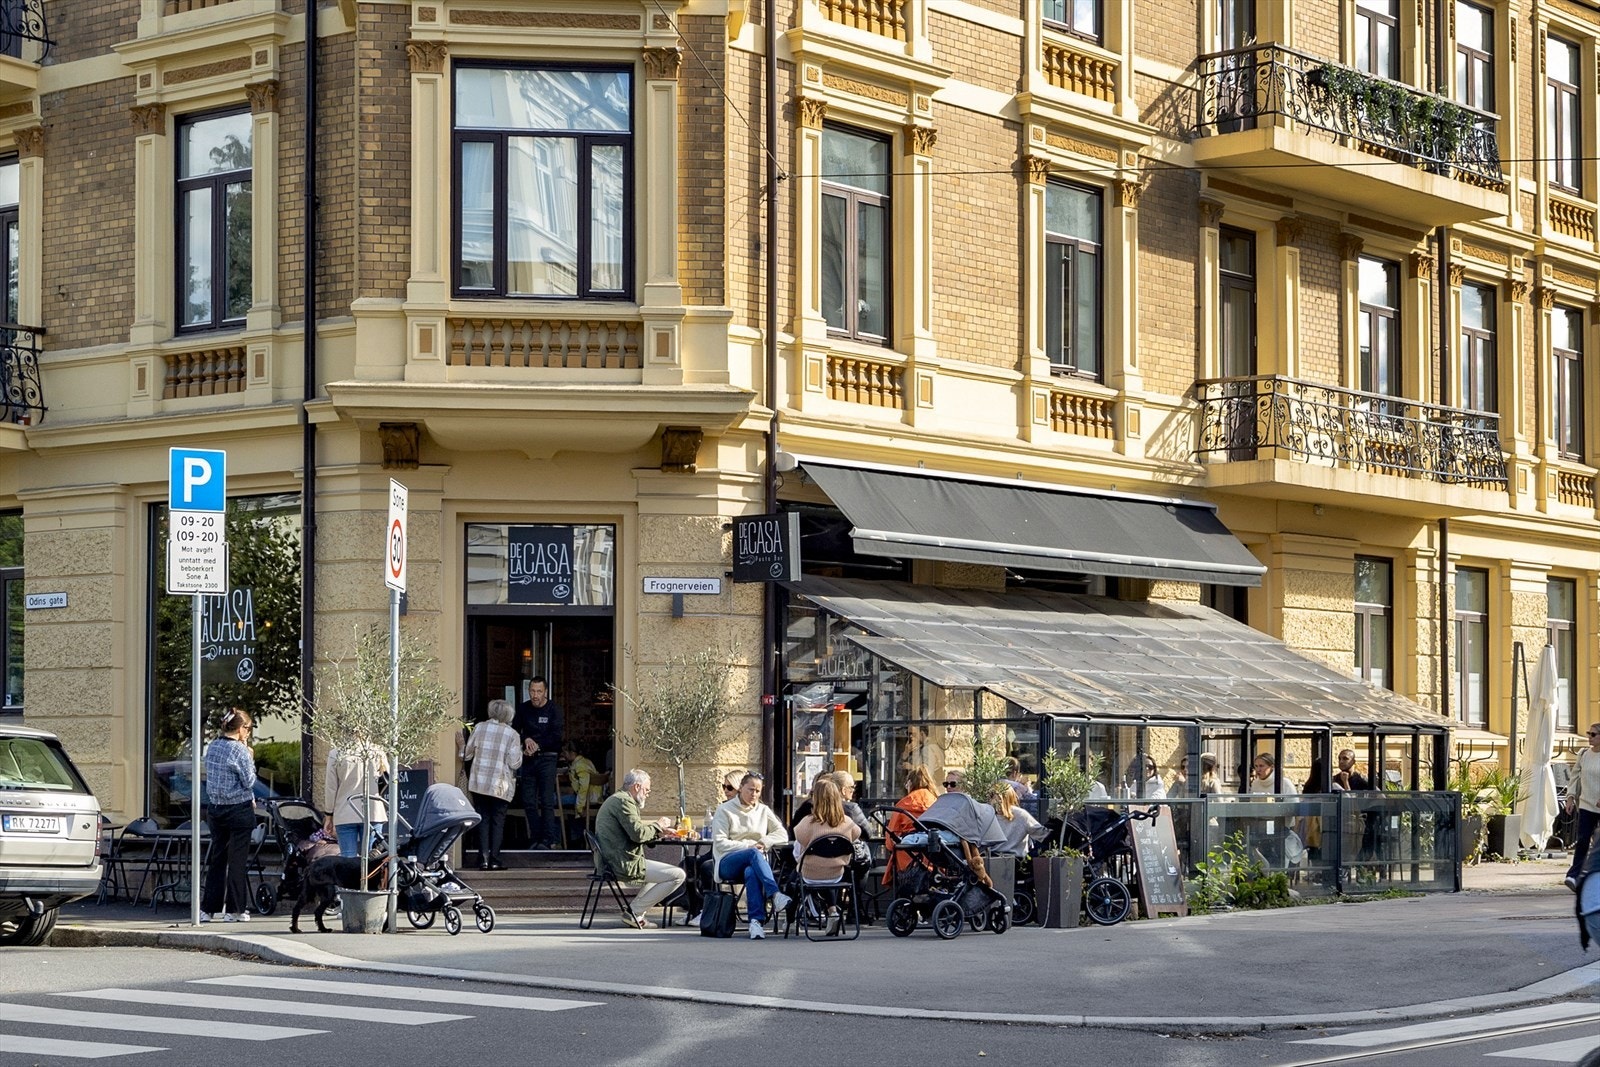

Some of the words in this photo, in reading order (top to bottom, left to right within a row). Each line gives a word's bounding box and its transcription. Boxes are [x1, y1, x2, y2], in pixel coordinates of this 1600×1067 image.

[183, 457, 212, 503] P
[180, 516, 214, 527] 09-20
[176, 530, 219, 543] (09-20)
[739, 522, 748, 539] DE
[748, 520, 783, 554] CASA
[195, 546, 214, 555] avgift
[392, 533, 403, 564] 30
[739, 539, 749, 555] LA
[178, 556, 201, 564] unntatt
[203, 557, 216, 565] med
[510, 542, 522, 558] DE
[523, 542, 572, 575] CASA
[180, 565, 214, 573] beboerkort
[510, 558, 523, 575] LA
[532, 575, 554, 583] Pasta
[558, 575, 571, 583] Bar
[650, 580, 714, 593] Frognerveien
[29, 597, 47, 606] Odins
[48, 596, 64, 607] gate
[209, 588, 256, 643] CASA
[218, 644, 239, 656] Pasta
[243, 643, 256, 655] Bar
[12, 817, 27, 829] RK
[29, 818, 56, 829] 72277
